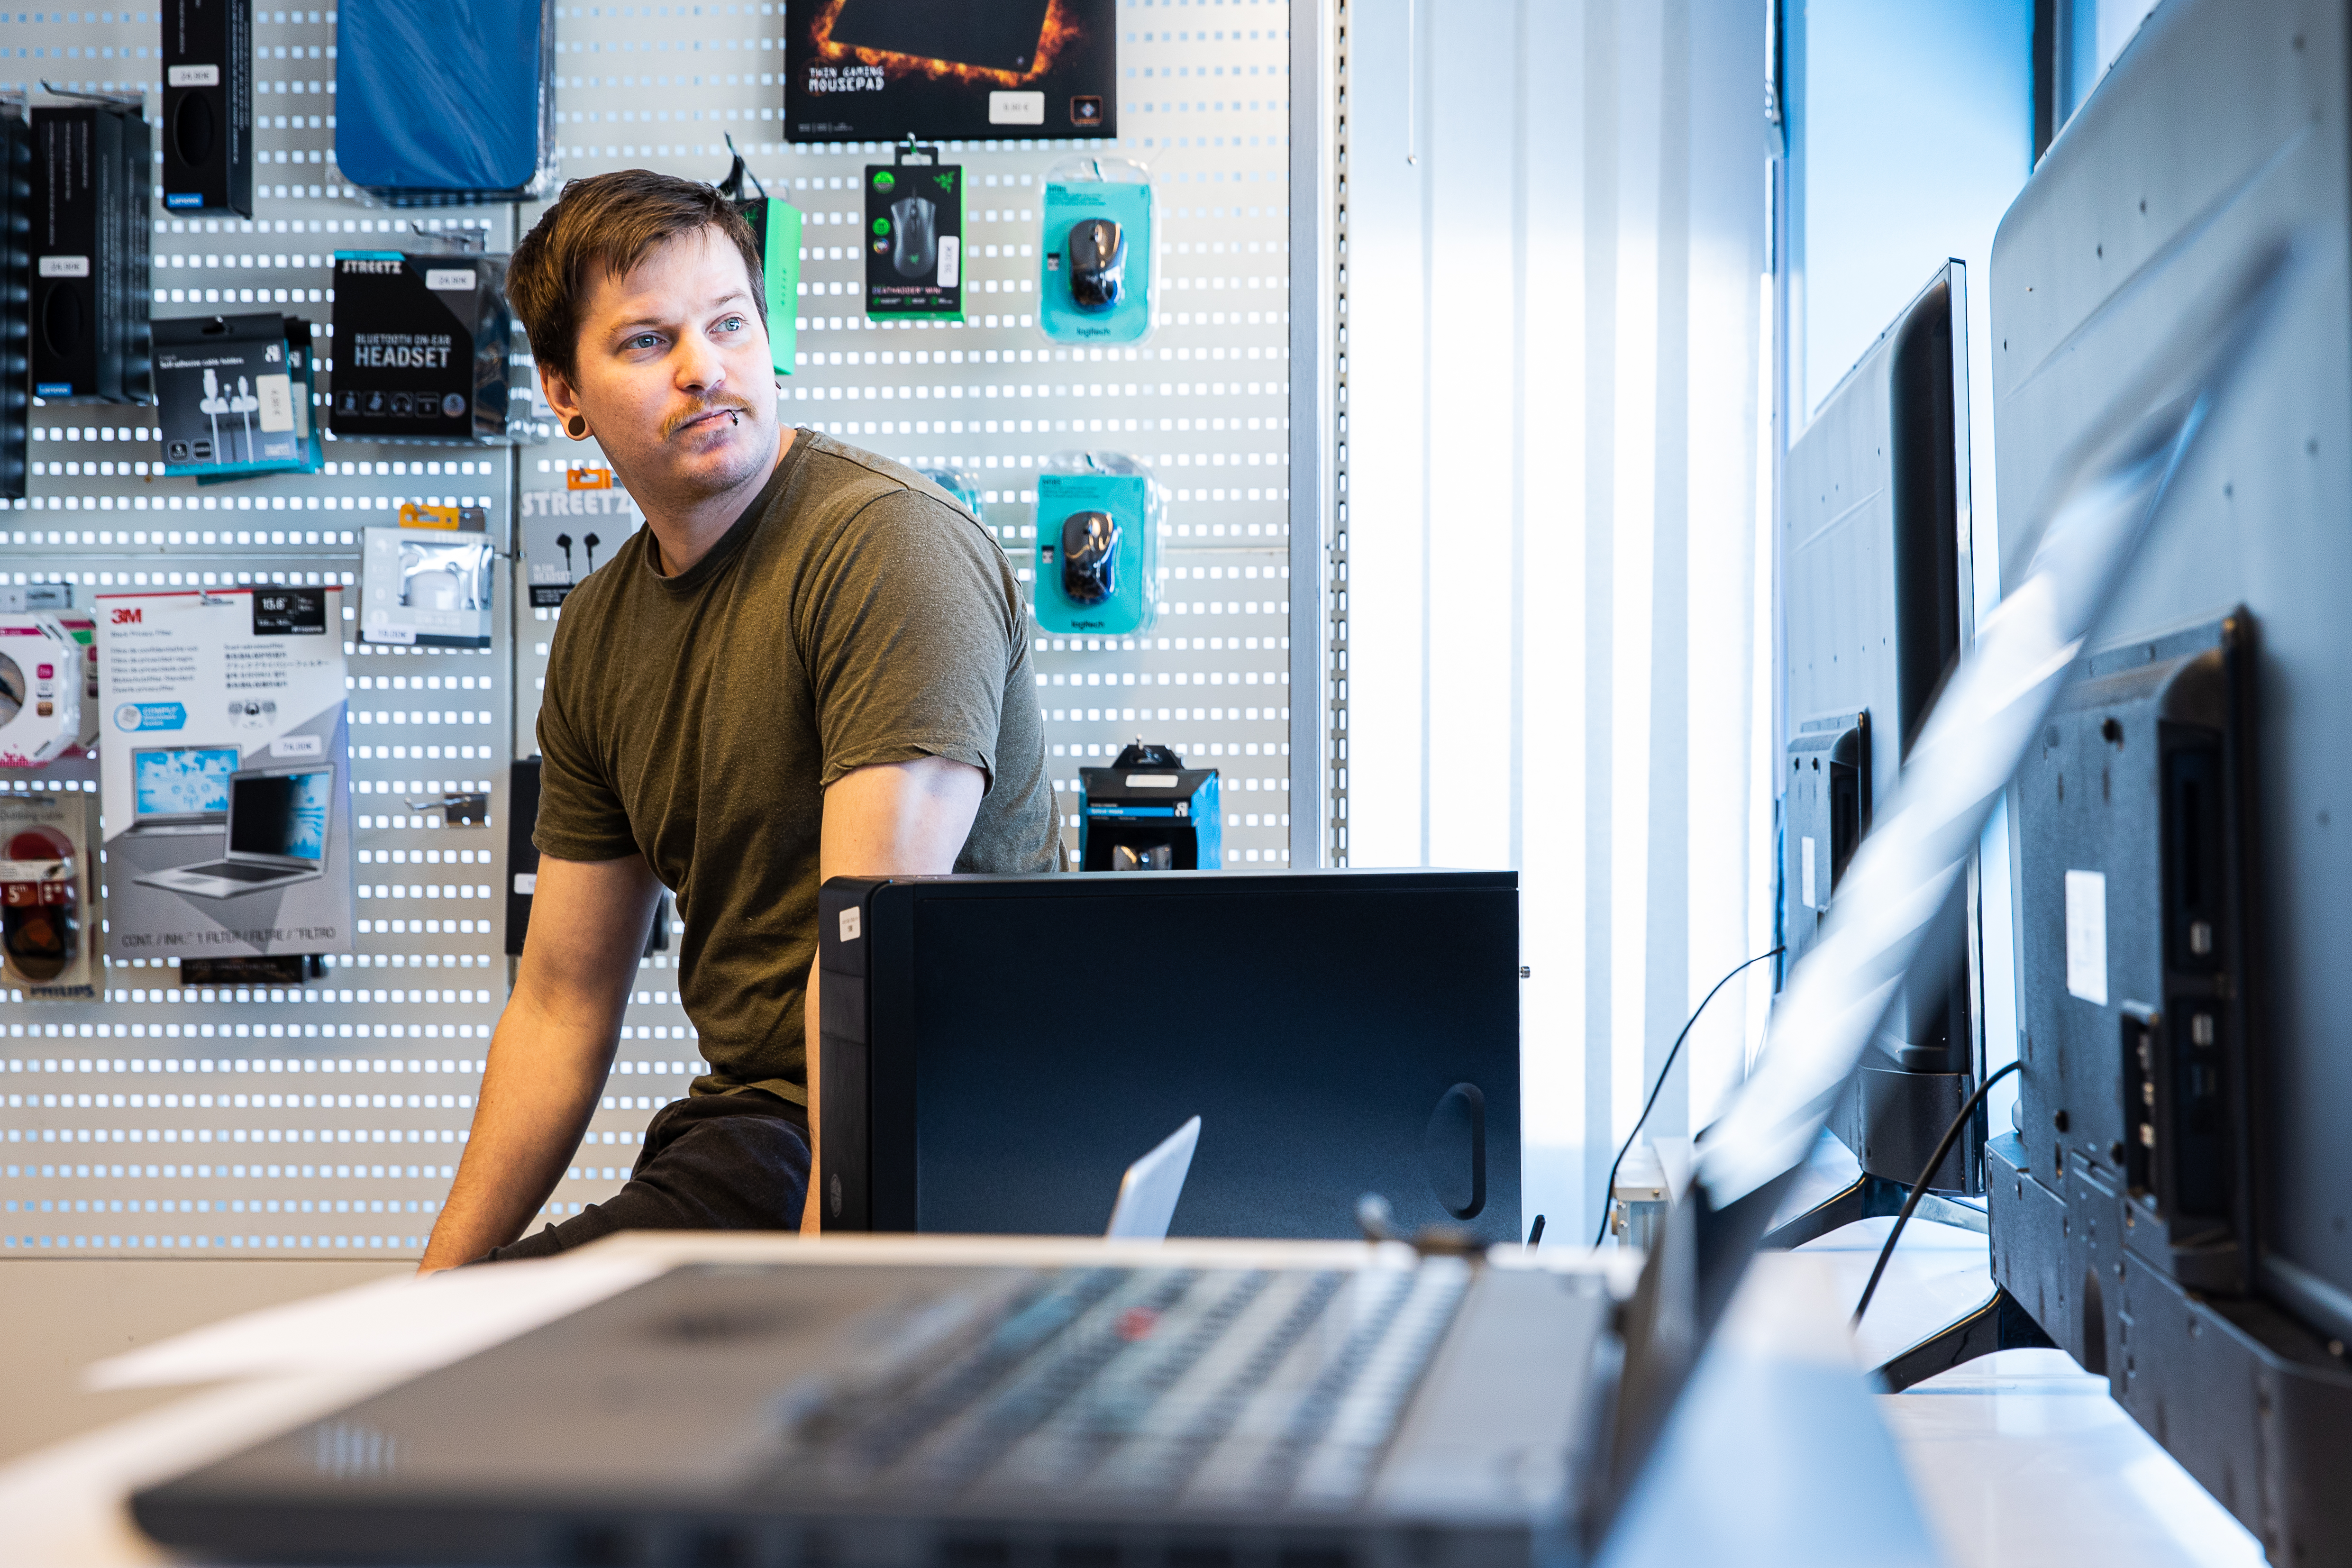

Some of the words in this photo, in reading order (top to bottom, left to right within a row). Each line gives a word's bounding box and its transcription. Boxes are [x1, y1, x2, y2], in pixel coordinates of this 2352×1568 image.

[843, 65, 885, 78] GAMING
[809, 76, 884, 92] MOUSEPAD
[342, 260, 402, 274] STREETZ
[355, 333, 412, 345] BLUETOOTH
[414, 334, 451, 346] ON-EAR
[355, 346, 451, 368] HEADSET
[522, 488, 631, 517] STREETZ
[111, 609, 141, 624] 3M
[1071, 620, 1105, 631] logitech
